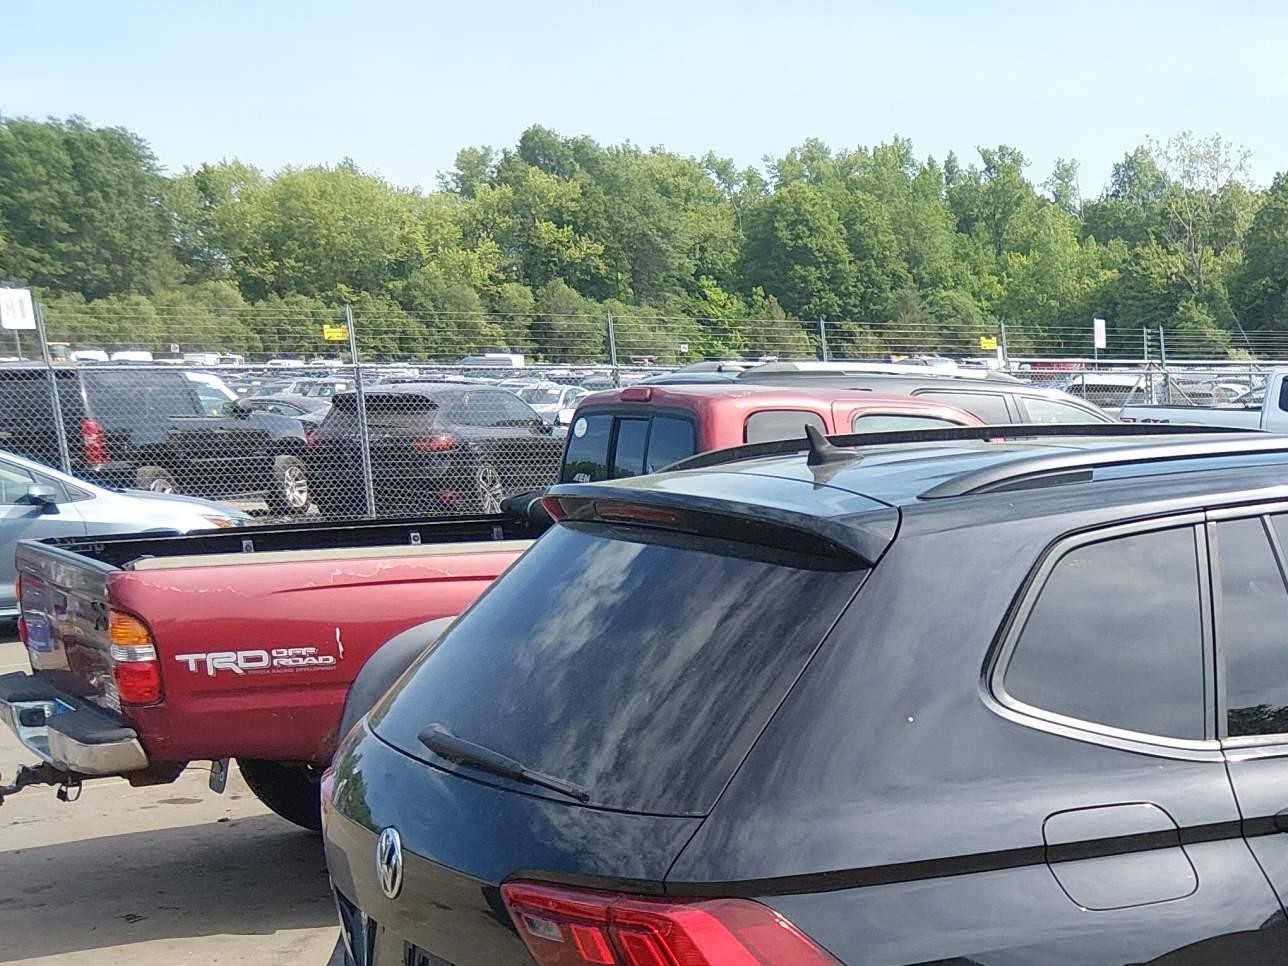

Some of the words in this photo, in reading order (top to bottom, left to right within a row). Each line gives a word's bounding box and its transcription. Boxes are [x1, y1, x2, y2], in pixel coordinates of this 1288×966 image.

[271, 647, 318, 656] OFF
[175, 649, 270, 676] TRD
[272, 655, 336, 667] ROAD
